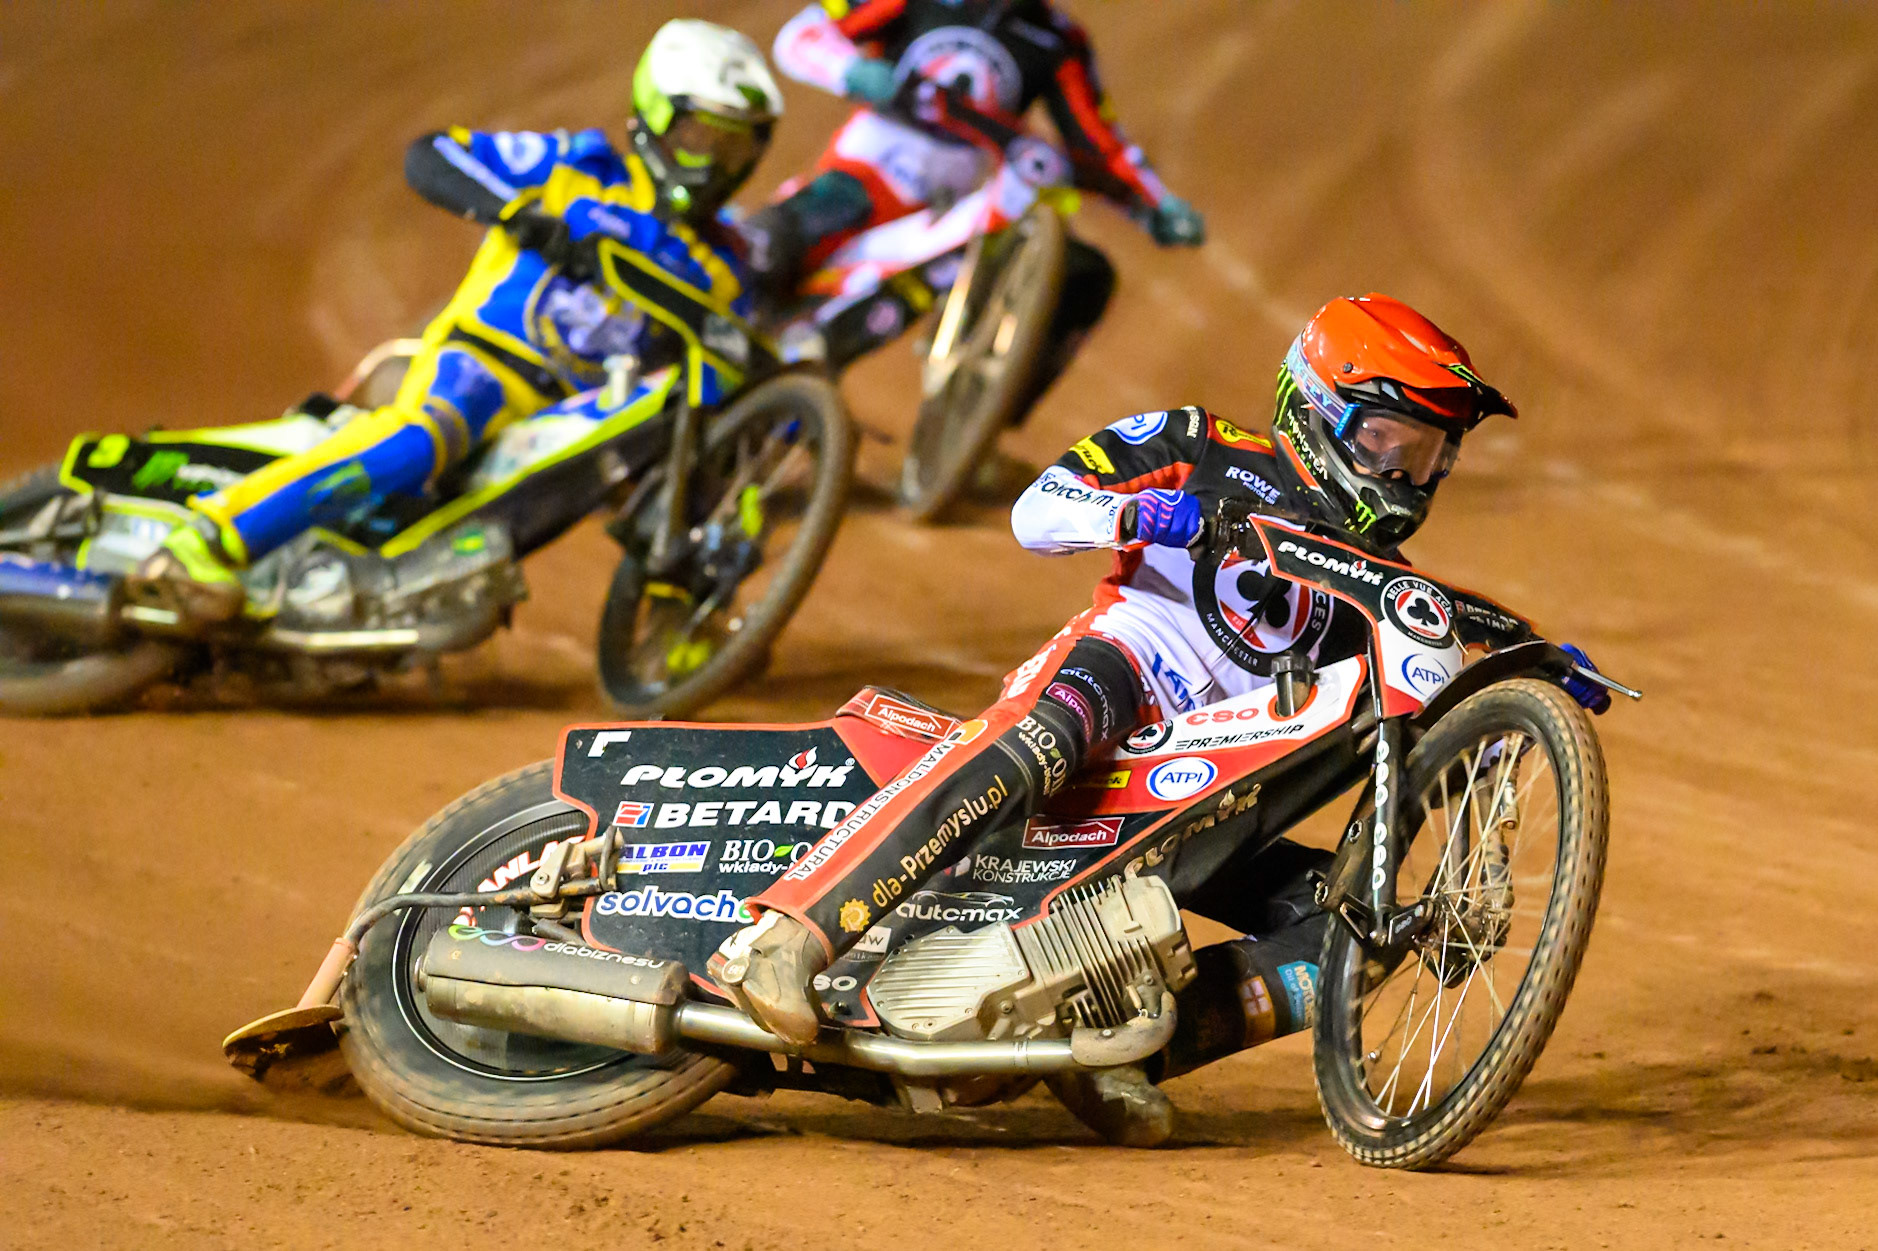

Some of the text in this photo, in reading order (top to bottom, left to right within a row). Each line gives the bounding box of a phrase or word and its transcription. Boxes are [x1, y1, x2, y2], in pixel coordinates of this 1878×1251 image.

[1225, 466, 1281, 501] ROWE
[1386, 581, 1410, 600] BELLE
[1412, 581, 1432, 595] VUE
[1311, 591, 1327, 631] CES
[1411, 667, 1445, 685] ATPI
[878, 707, 936, 732] Alpodach
[1055, 688, 1091, 744] Alpo
[1182, 724, 1304, 750] PREMIERSHIP
[1160, 772, 1203, 784] ATPI
[654, 801, 857, 829] BETARD
[872, 775, 1008, 908] dla-Przemyslu.pl
[1031, 829, 1107, 845] Alpodach
[619, 844, 707, 859] ALBON
[642, 863, 669, 872] plc
[975, 854, 1077, 873] KRAJEWSKI
[973, 868, 1071, 883] KONSTRUKCJE
[896, 903, 1024, 922] automax
[543, 941, 665, 969] dlabiznesu
[813, 974, 857, 991] SO
